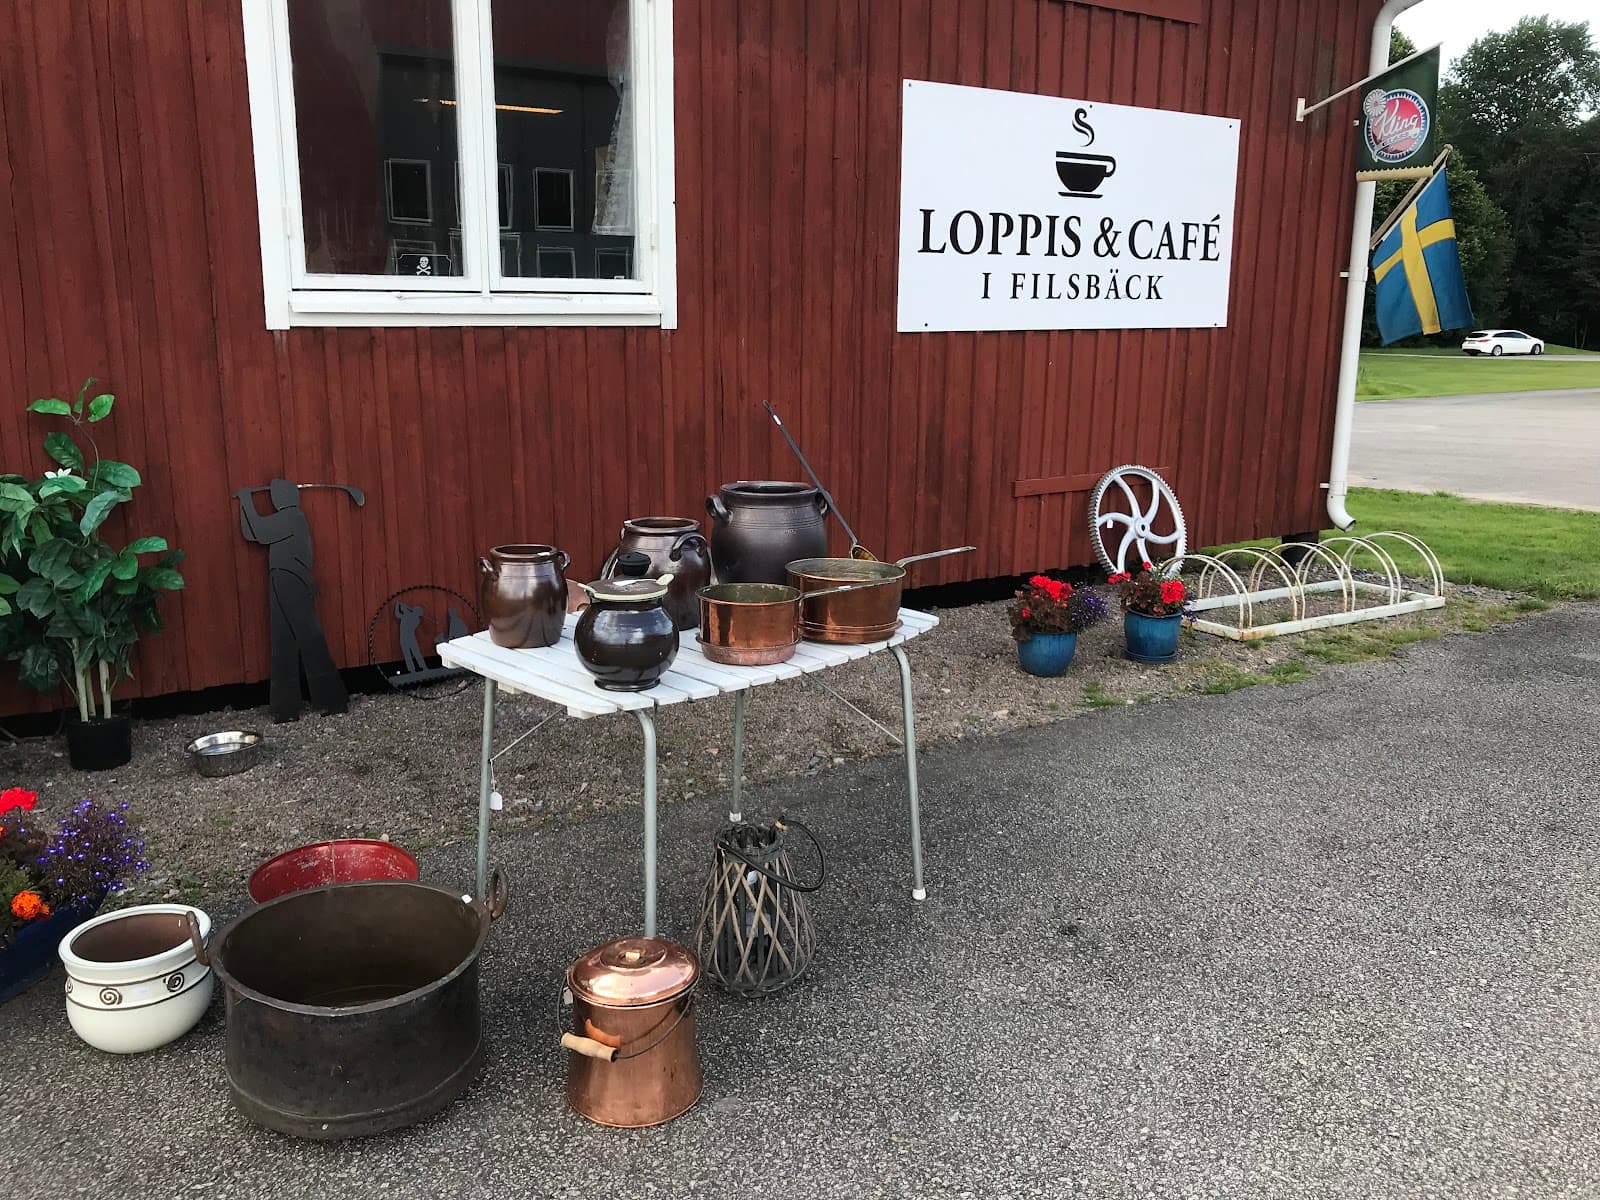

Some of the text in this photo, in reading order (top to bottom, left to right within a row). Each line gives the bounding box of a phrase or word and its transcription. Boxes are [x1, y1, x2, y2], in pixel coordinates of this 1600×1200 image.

[917, 208, 1221, 262] LOPPIS & CAFÉ
[981, 268, 1164, 300] I FILSBÄCK
